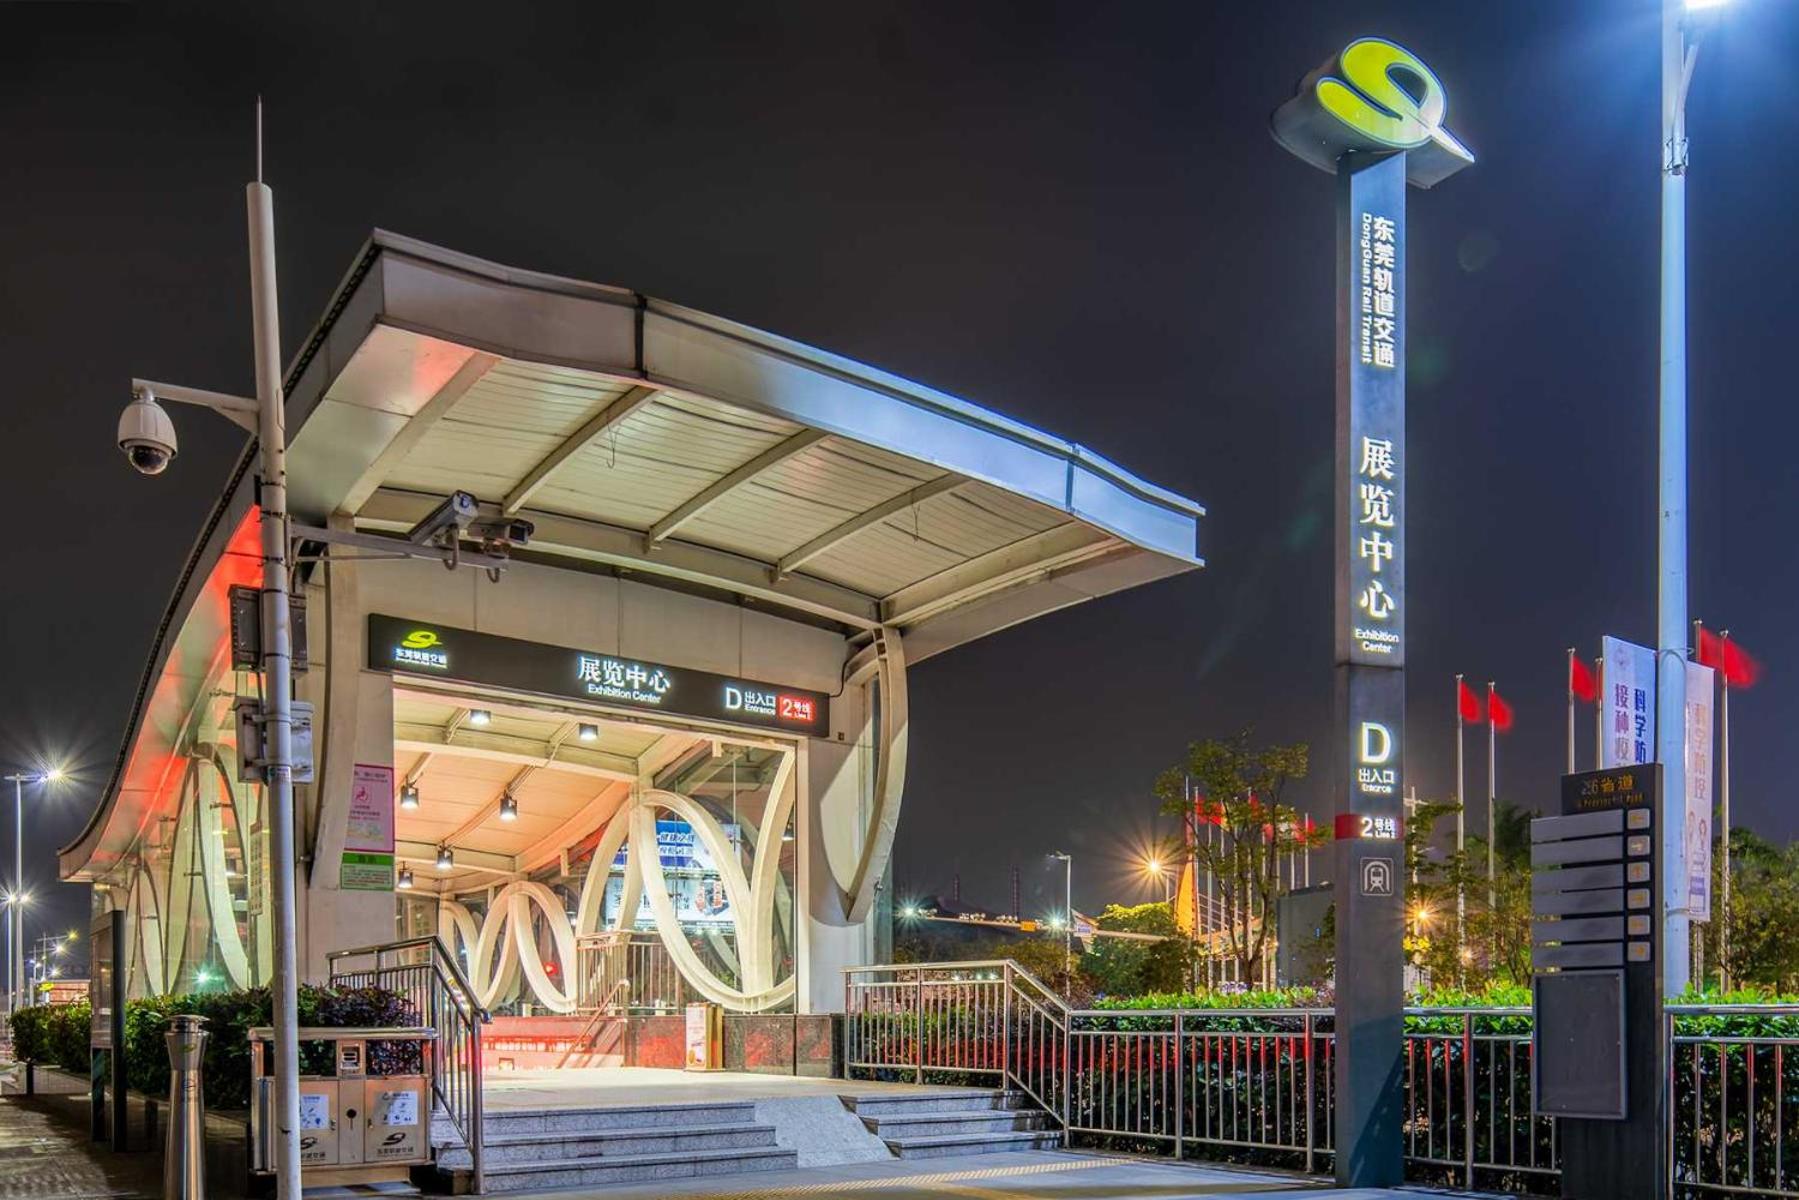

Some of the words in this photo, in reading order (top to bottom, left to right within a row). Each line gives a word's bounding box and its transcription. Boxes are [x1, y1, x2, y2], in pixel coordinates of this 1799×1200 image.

[1361, 286, 1373, 313] Rail
[1373, 216, 1395, 368] 东莞轨道交通
[1361, 315, 1373, 364] Transit
[1360, 436, 1395, 618] 展览中心
[1355, 628, 1400, 643] Exhibition
[1362, 640, 1392, 653] Center
[577, 655, 671, 693] 展览中心
[588, 683, 632, 700] Exhibition
[632, 689, 662, 704] Center
[725, 687, 742, 709] D
[744, 690, 776, 707] 出入口
[744, 703, 776, 716] Entrance
[1615, 683, 1630, 767] 接种疫
[1361, 722, 1392, 763] D
[1358, 768, 1395, 784] 出入口
[1361, 783, 1393, 793] Entrance
